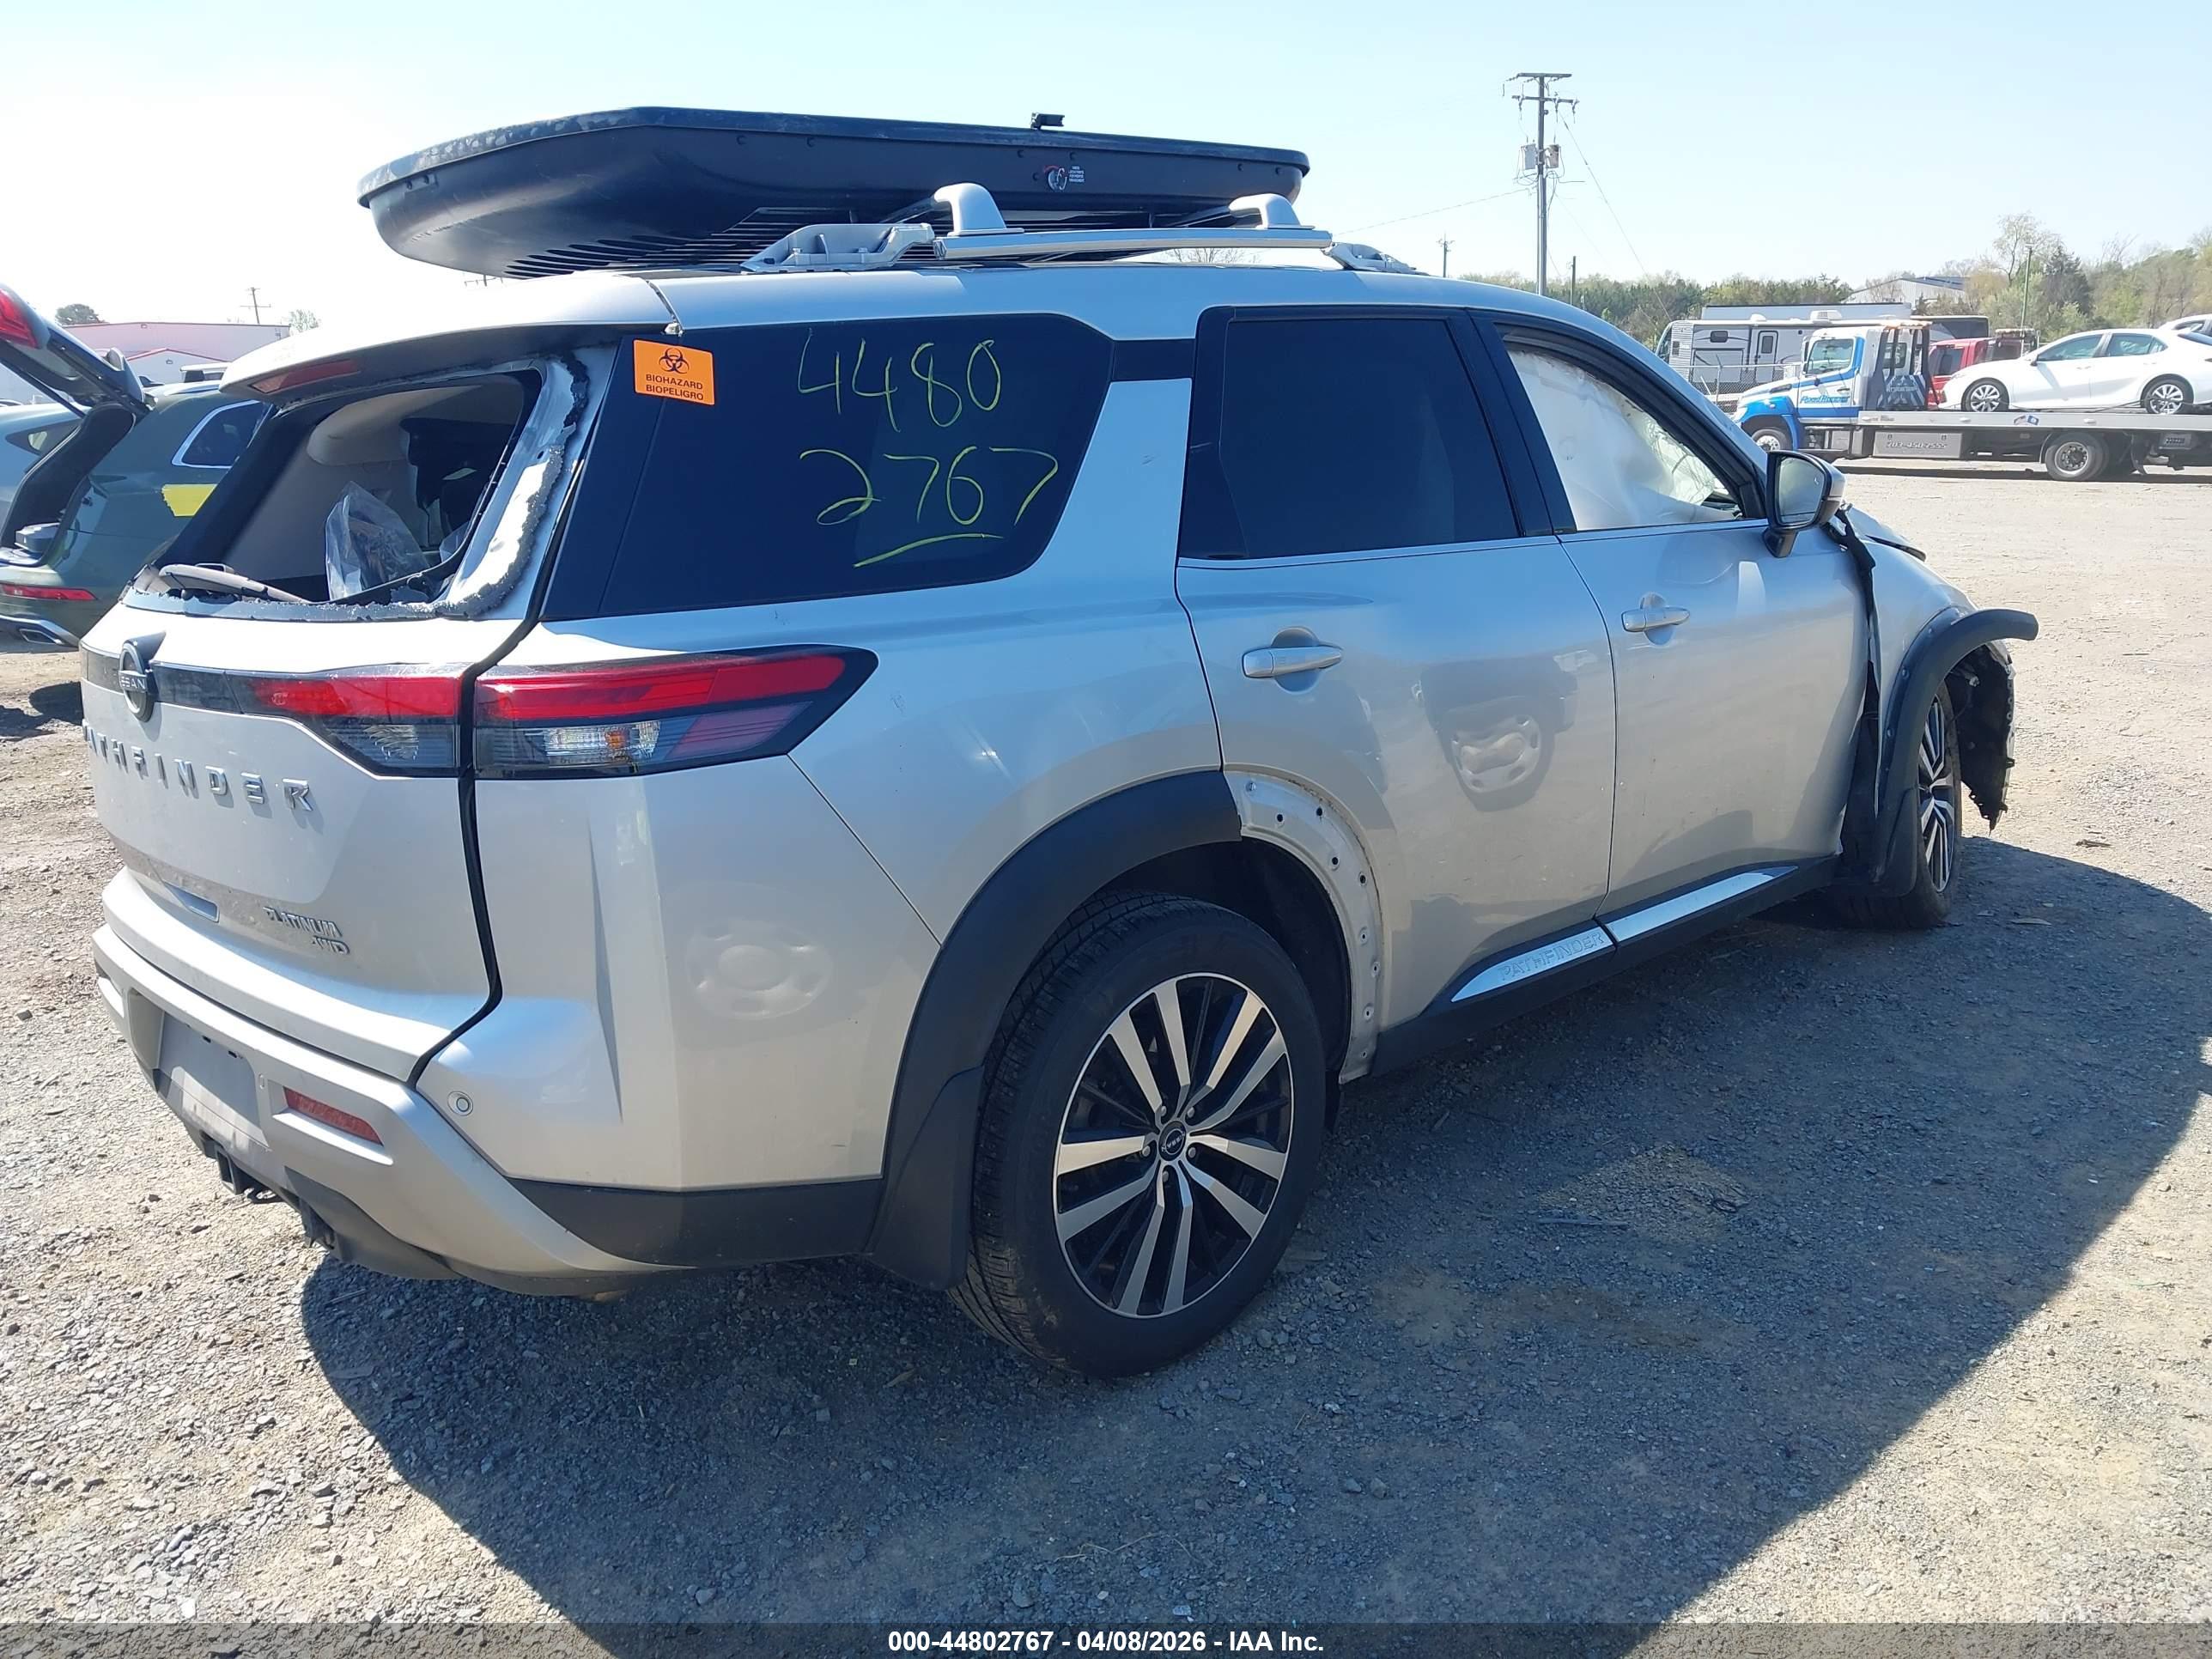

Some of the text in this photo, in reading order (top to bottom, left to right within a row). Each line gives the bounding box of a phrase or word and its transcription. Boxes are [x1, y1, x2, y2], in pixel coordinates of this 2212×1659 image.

[646, 374, 703, 390] BIOHAZARD
[646, 384, 704, 401] BIOPELIGRO
[797, 328, 1003, 432] 4480
[799, 446, 1059, 526] 2767
[1498, 932, 1604, 981] PATHFINDER
